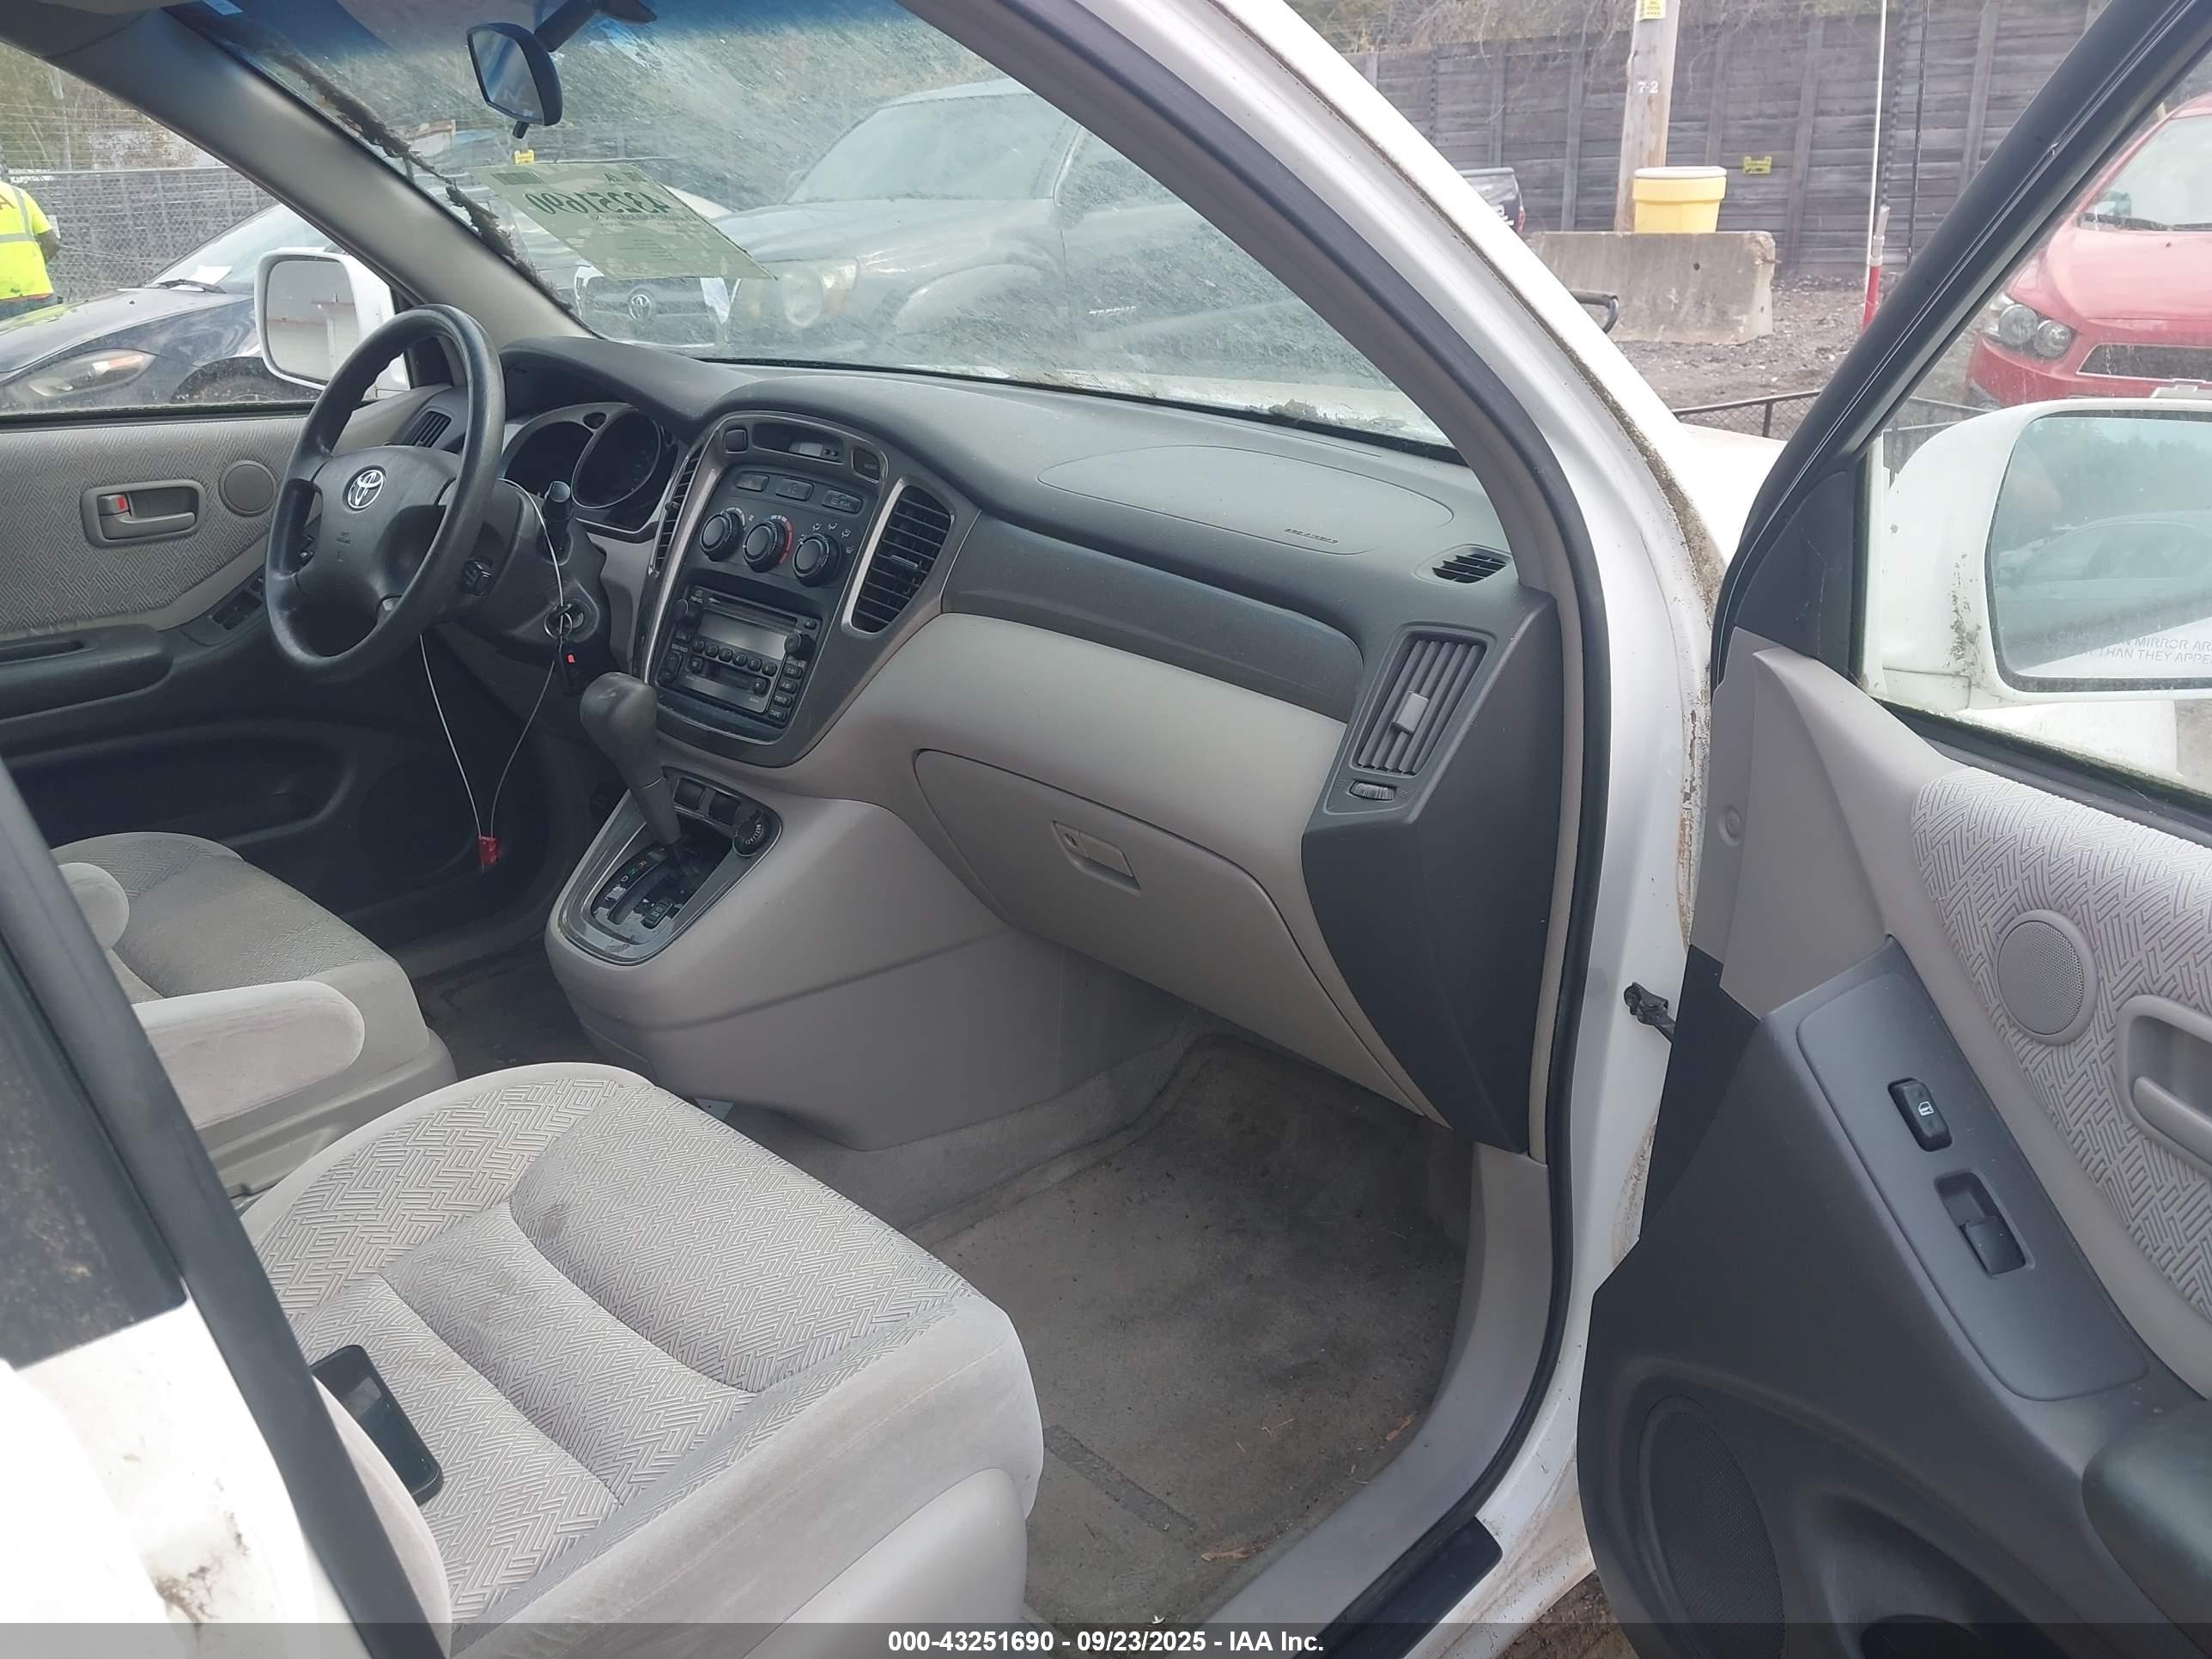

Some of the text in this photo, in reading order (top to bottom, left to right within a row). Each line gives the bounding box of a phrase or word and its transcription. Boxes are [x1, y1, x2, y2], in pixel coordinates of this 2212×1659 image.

[1637, 82, 1660, 94] 7-2
[2134, 637, 2188, 649] MIRROR
[2192, 641, 2212, 652] AR
[2137, 649, 2172, 661] THEY
[2174, 653, 2212, 665] APPE
